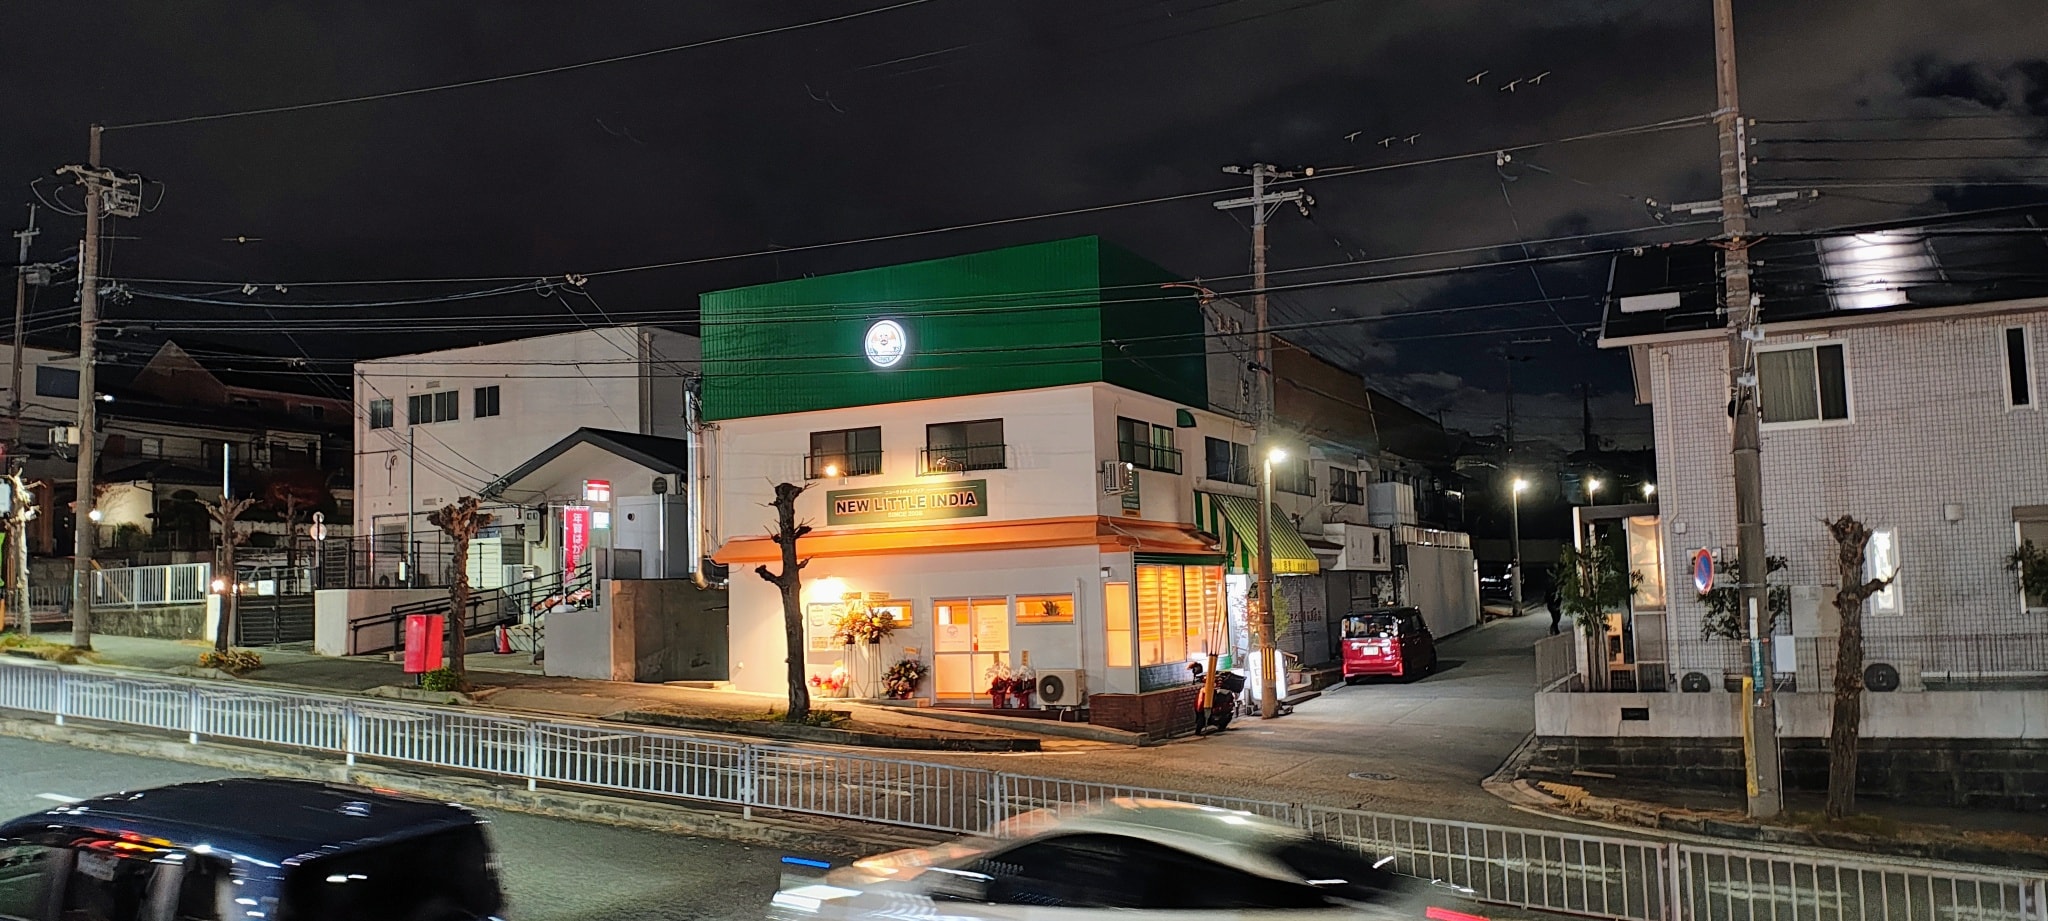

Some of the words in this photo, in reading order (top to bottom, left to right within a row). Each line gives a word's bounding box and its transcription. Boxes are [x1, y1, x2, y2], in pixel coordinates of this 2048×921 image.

[836, 499, 870, 515] NEW
[874, 495, 926, 511] LITTLE
[931, 491, 976, 507] INDIA
